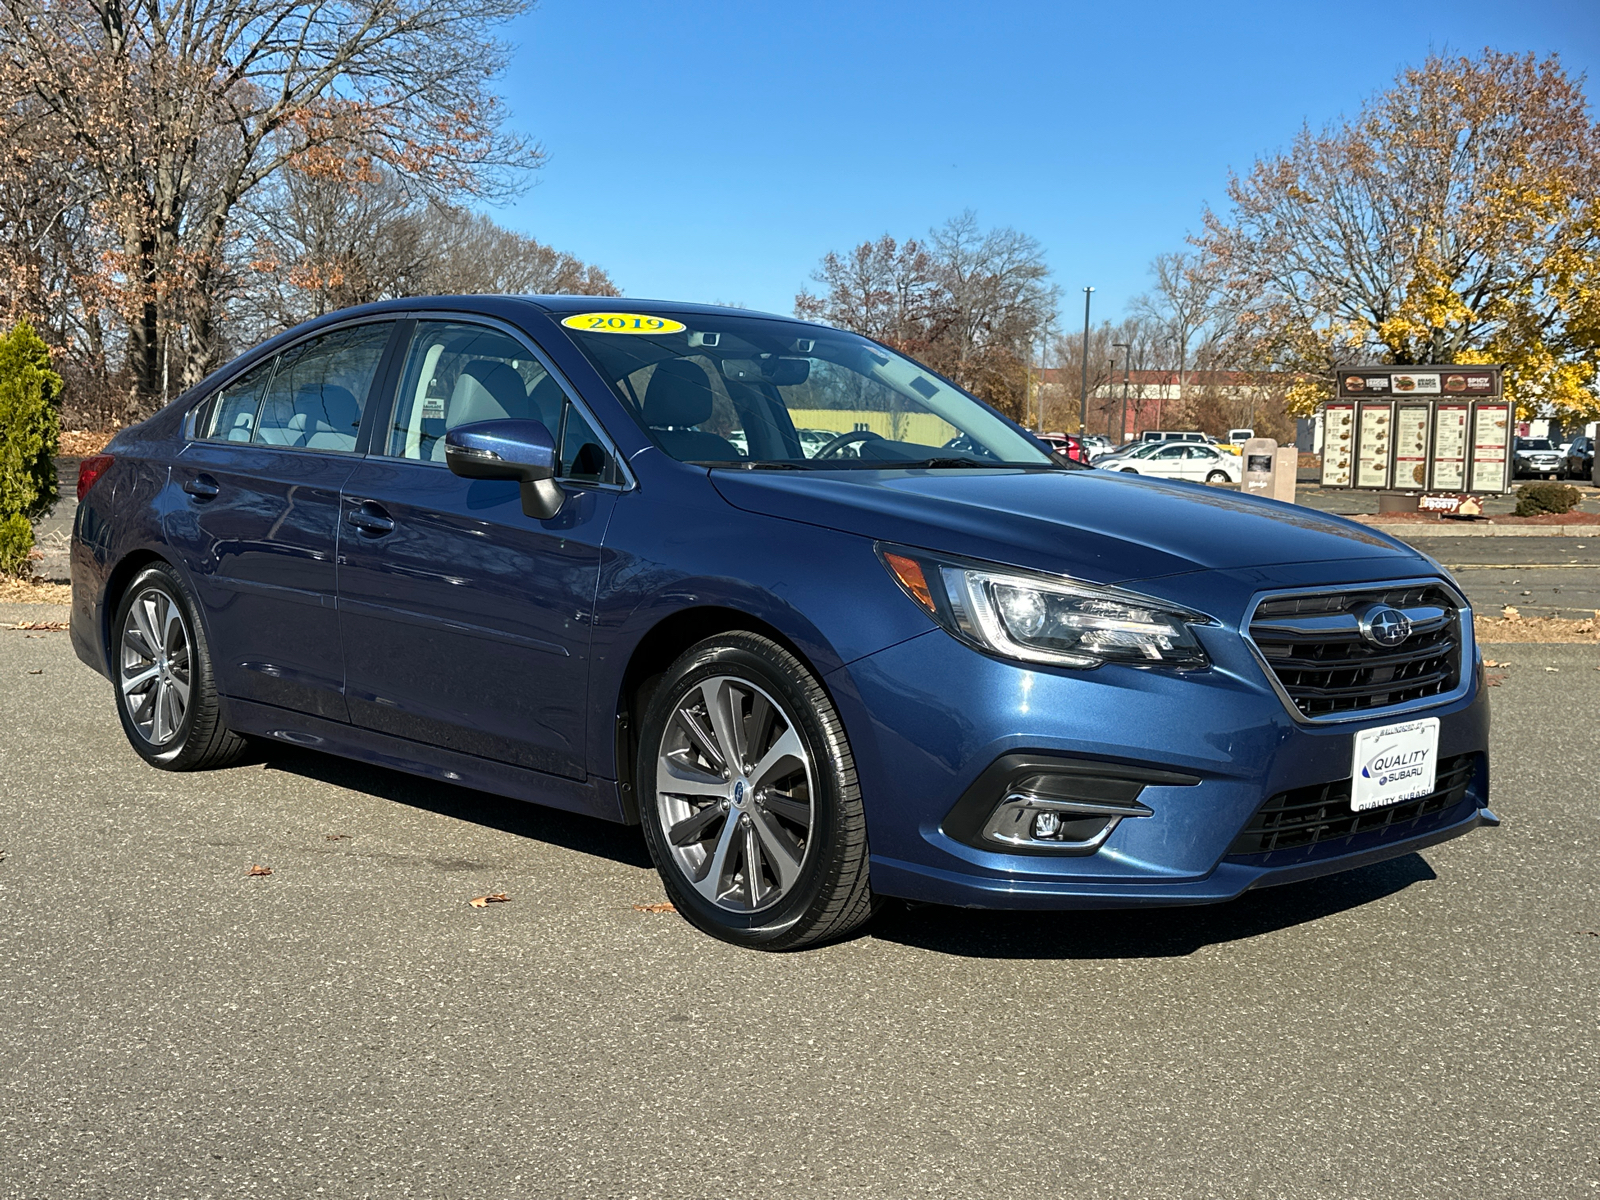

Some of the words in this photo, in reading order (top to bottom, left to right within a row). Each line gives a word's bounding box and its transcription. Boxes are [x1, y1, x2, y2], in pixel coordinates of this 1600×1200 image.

[588, 317, 665, 330] 2019
[1374, 749, 1429, 771] QUALITY
[1388, 767, 1423, 782] SUBARU
[1358, 796, 1395, 811] QUALITY
[1398, 787, 1433, 801] SUBARU
